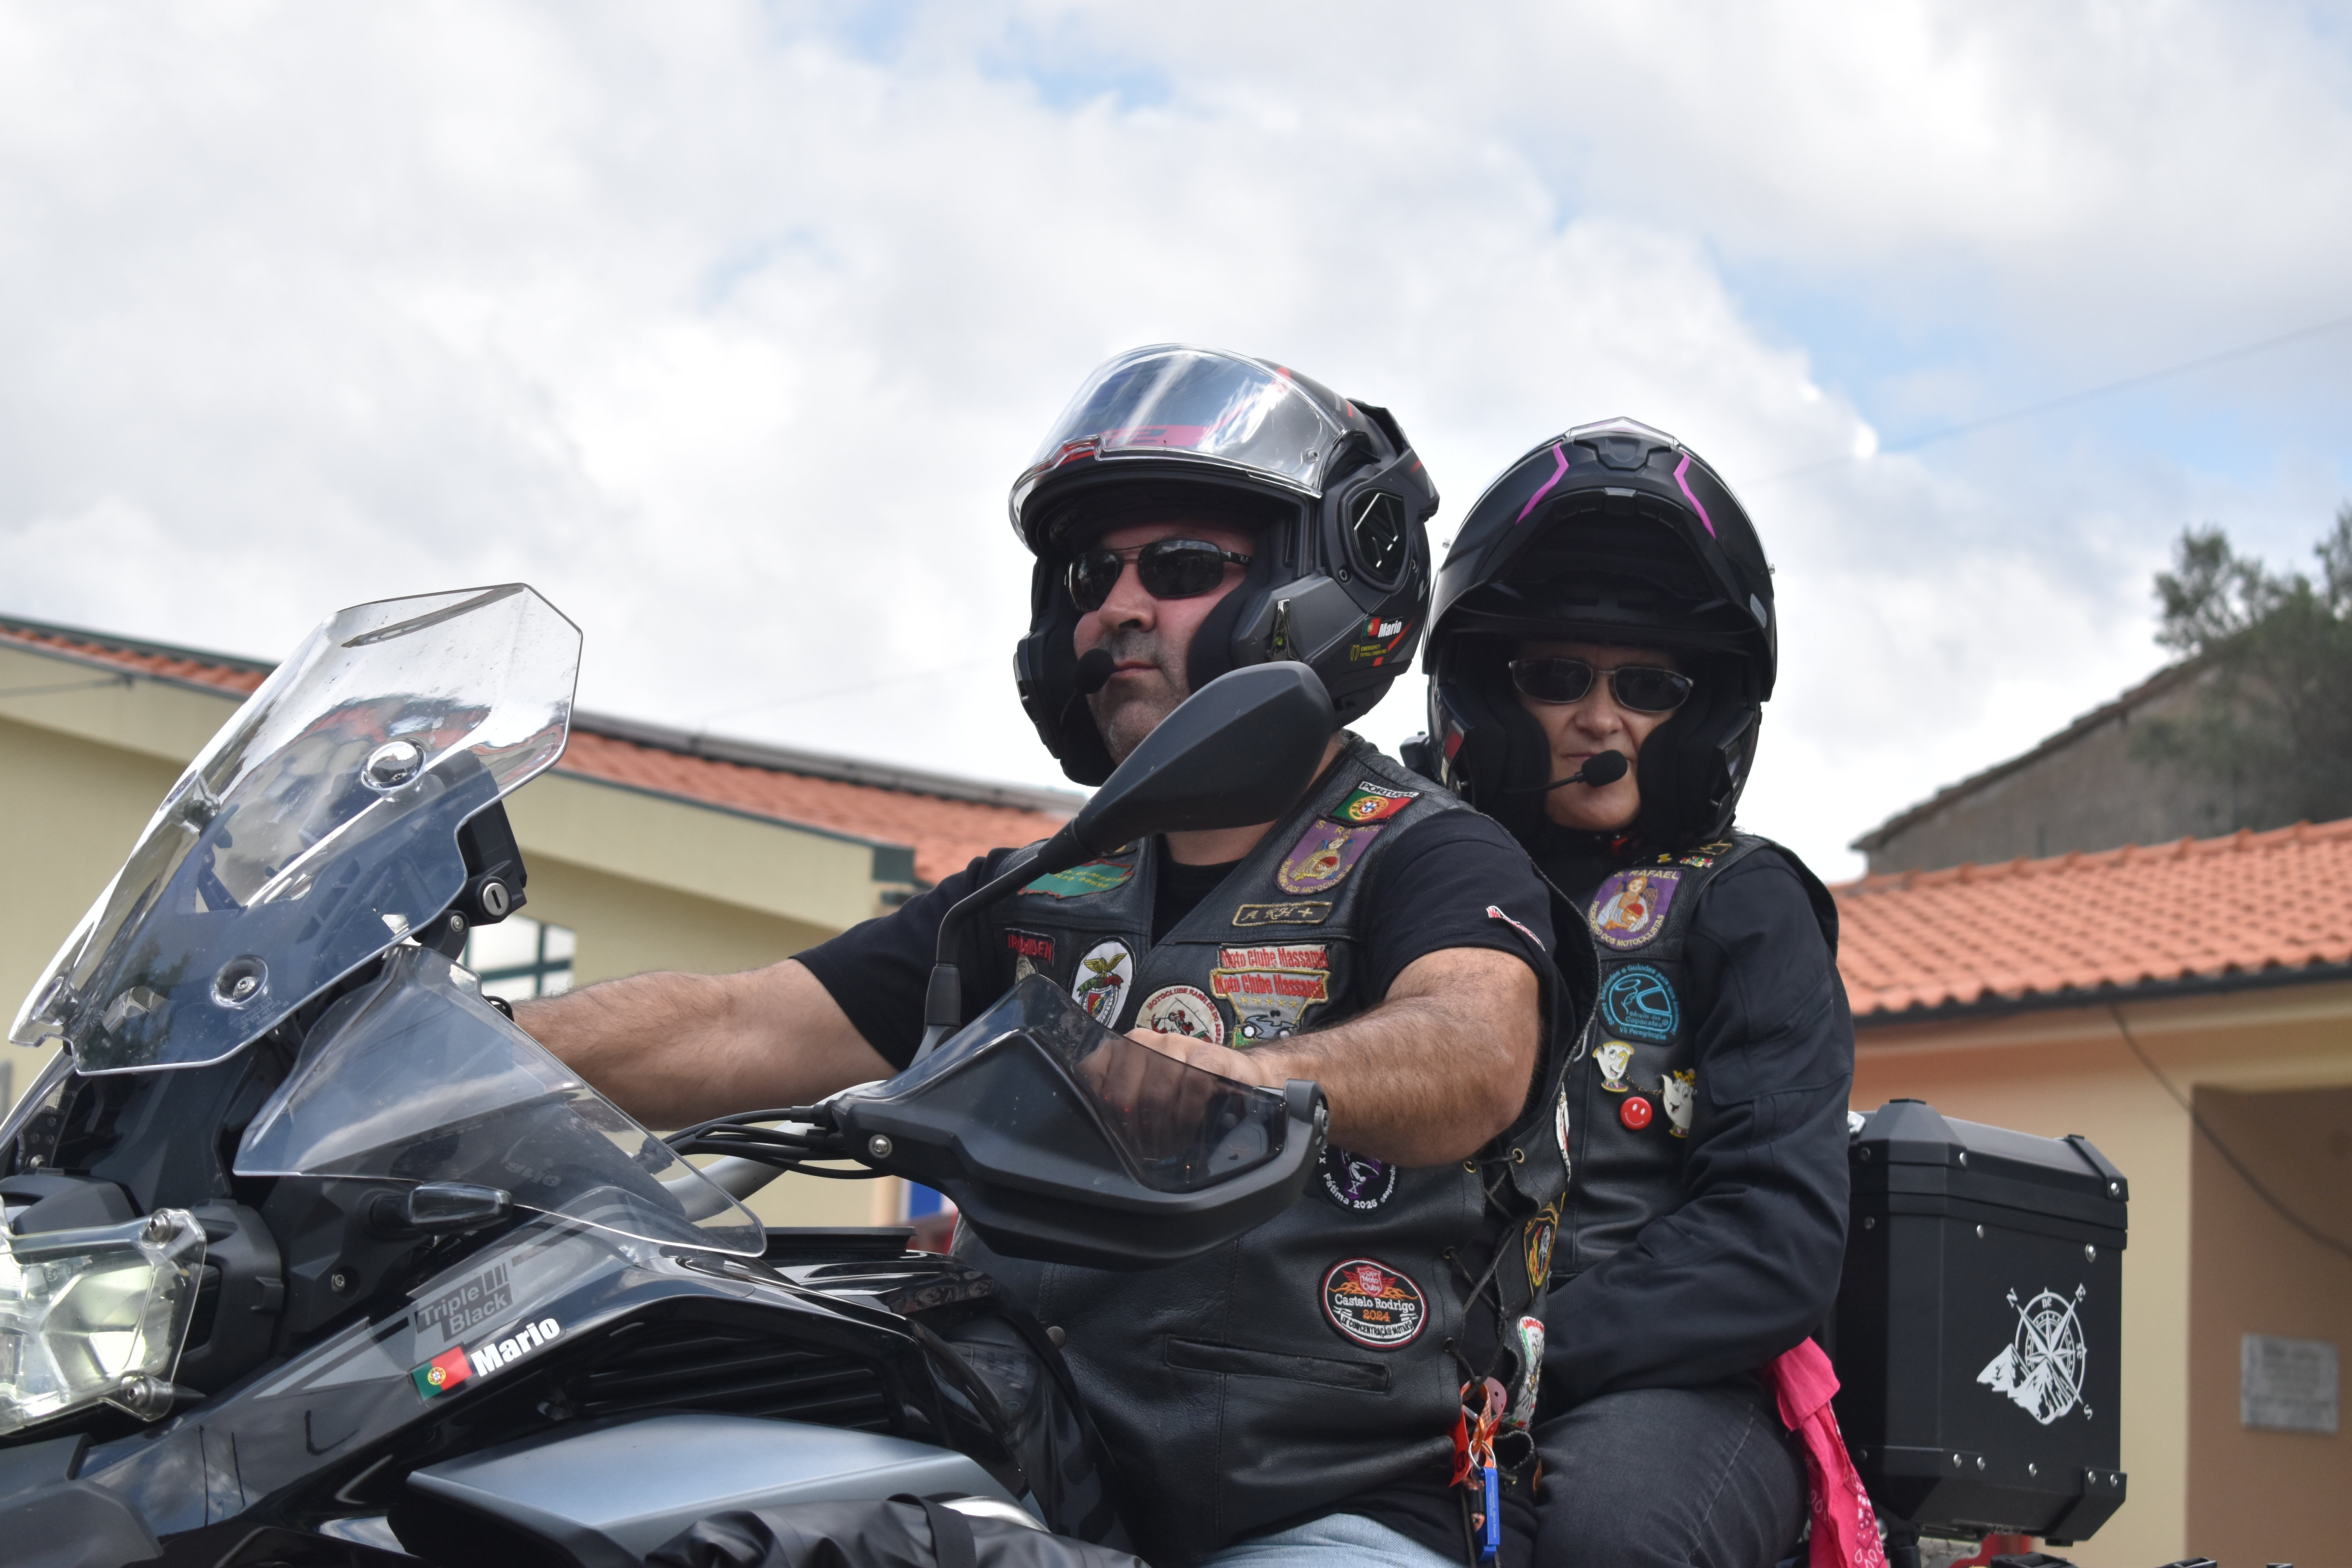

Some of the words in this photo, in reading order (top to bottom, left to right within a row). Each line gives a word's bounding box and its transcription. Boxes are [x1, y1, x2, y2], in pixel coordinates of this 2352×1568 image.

[1377, 620, 1402, 637] Mario
[1361, 782, 1416, 797] PORTUGAL
[1628, 869, 1679, 880] RAFAEL
[1286, 884, 1300, 893] DOS
[1590, 901, 1602, 935] PADROEIRO
[1601, 933, 1615, 944] DOS
[1617, 914, 1664, 947] MOTOCICLISTAS
[1221, 949, 1246, 968] Moto
[1248, 947, 1278, 967] Clube
[1278, 946, 1329, 968] Massamá
[1627, 964, 1656, 974] Guiados
[1213, 974, 1241, 994] Moto
[1241, 973, 1273, 994] Clube
[1273, 974, 1325, 999] Massamá
[1147, 987, 1188, 1011] MOTOCLUBE
[1189, 989, 1215, 1012] RABELOS
[1212, 1011, 1219, 1022] DO
[1626, 1016, 1663, 1028] Capacetes
[1629, 1028, 1666, 1040] Peregrinação
[1323, 1173, 1349, 1205] Fátima
[1354, 1198, 1377, 1209] 2025
[1361, 1276, 1379, 1284] Moto
[1363, 1282, 1381, 1291] Clube
[419, 1283, 480, 1327] Triple
[1335, 1293, 1373, 1307] Castelo
[1375, 1297, 1415, 1313] Rodrigo
[2042, 1297, 2053, 1309] ne
[450, 1292, 509, 1336] Black
[1362, 1309, 1391, 1323] 2024
[1348, 1319, 1391, 1338] CONCENTRAÇÃO
[470, 1317, 561, 1377] Mario
[2076, 1342, 2083, 1360] se
[2083, 1404, 2094, 1421] S
